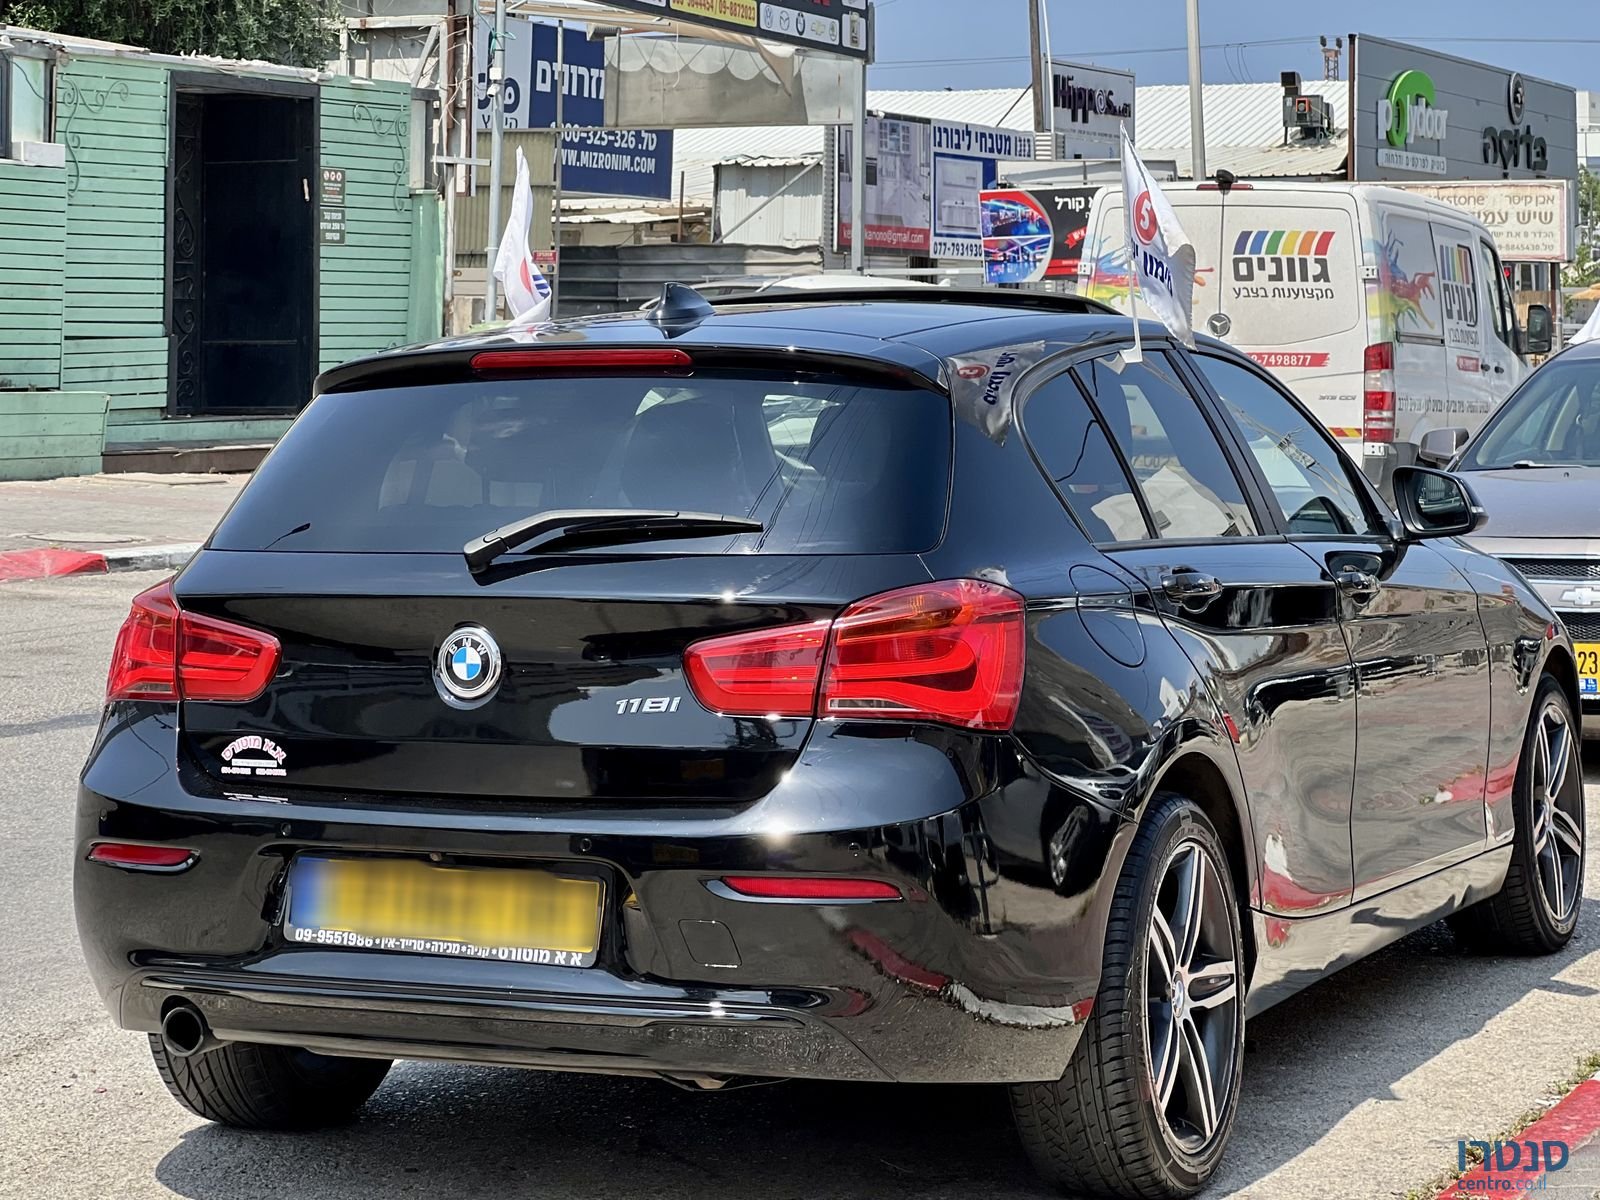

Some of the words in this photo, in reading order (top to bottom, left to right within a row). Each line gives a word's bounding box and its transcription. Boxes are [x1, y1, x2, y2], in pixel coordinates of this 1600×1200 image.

[536, 60, 605, 100] זרונים
[550, 121, 636, 150] 00-325-326
[933, 124, 972, 151] ליבורנו
[975, 131, 1011, 156] מטבחי
[1055, 196, 1085, 212] קורל
[1505, 195, 1531, 205] קיסר
[1535, 195, 1555, 205] אבן
[1516, 210, 1554, 225] שיש
[1232, 257, 1331, 283] גוונים
[1232, 286, 1269, 299] בצבע
[1272, 287, 1334, 301] מקצוענות
[448, 637, 487, 656] BMW
[615, 696, 682, 715] 118i
[221, 735, 263, 761] מוטורס
[498, 947, 550, 963] מוטורס
